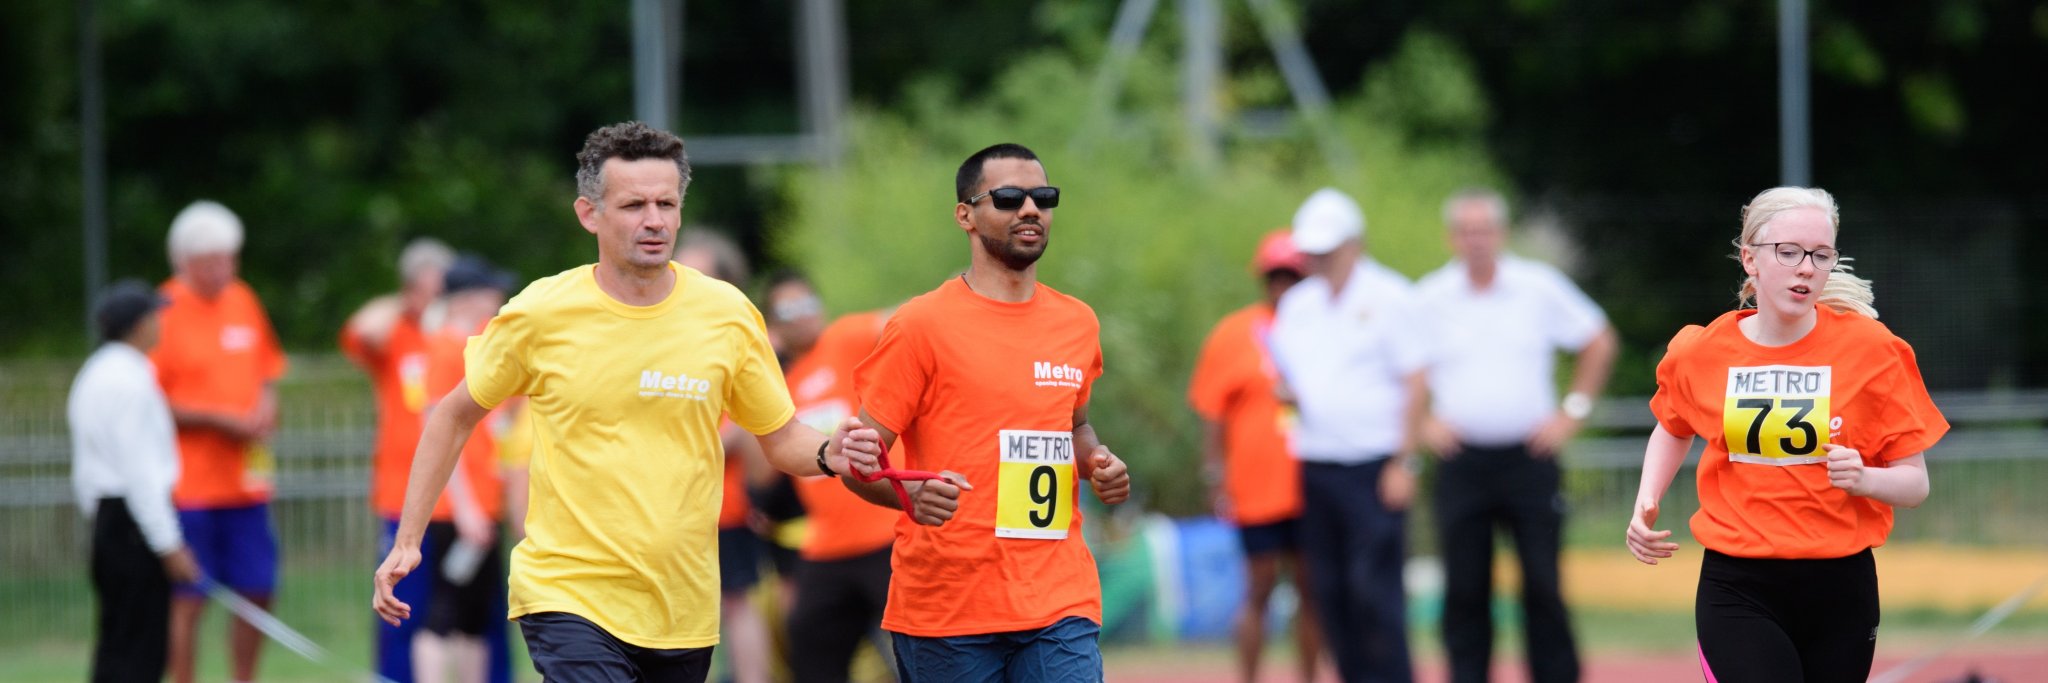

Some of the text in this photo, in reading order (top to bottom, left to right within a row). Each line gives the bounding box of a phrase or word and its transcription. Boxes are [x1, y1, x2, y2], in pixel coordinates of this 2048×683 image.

[640, 370, 710, 393] Metro
[1034, 361, 1083, 382] Metro
[1735, 370, 1821, 393] METRO
[1737, 398, 1818, 456] 73
[1009, 435, 1070, 460] METRO
[1029, 465, 1057, 528] 9
